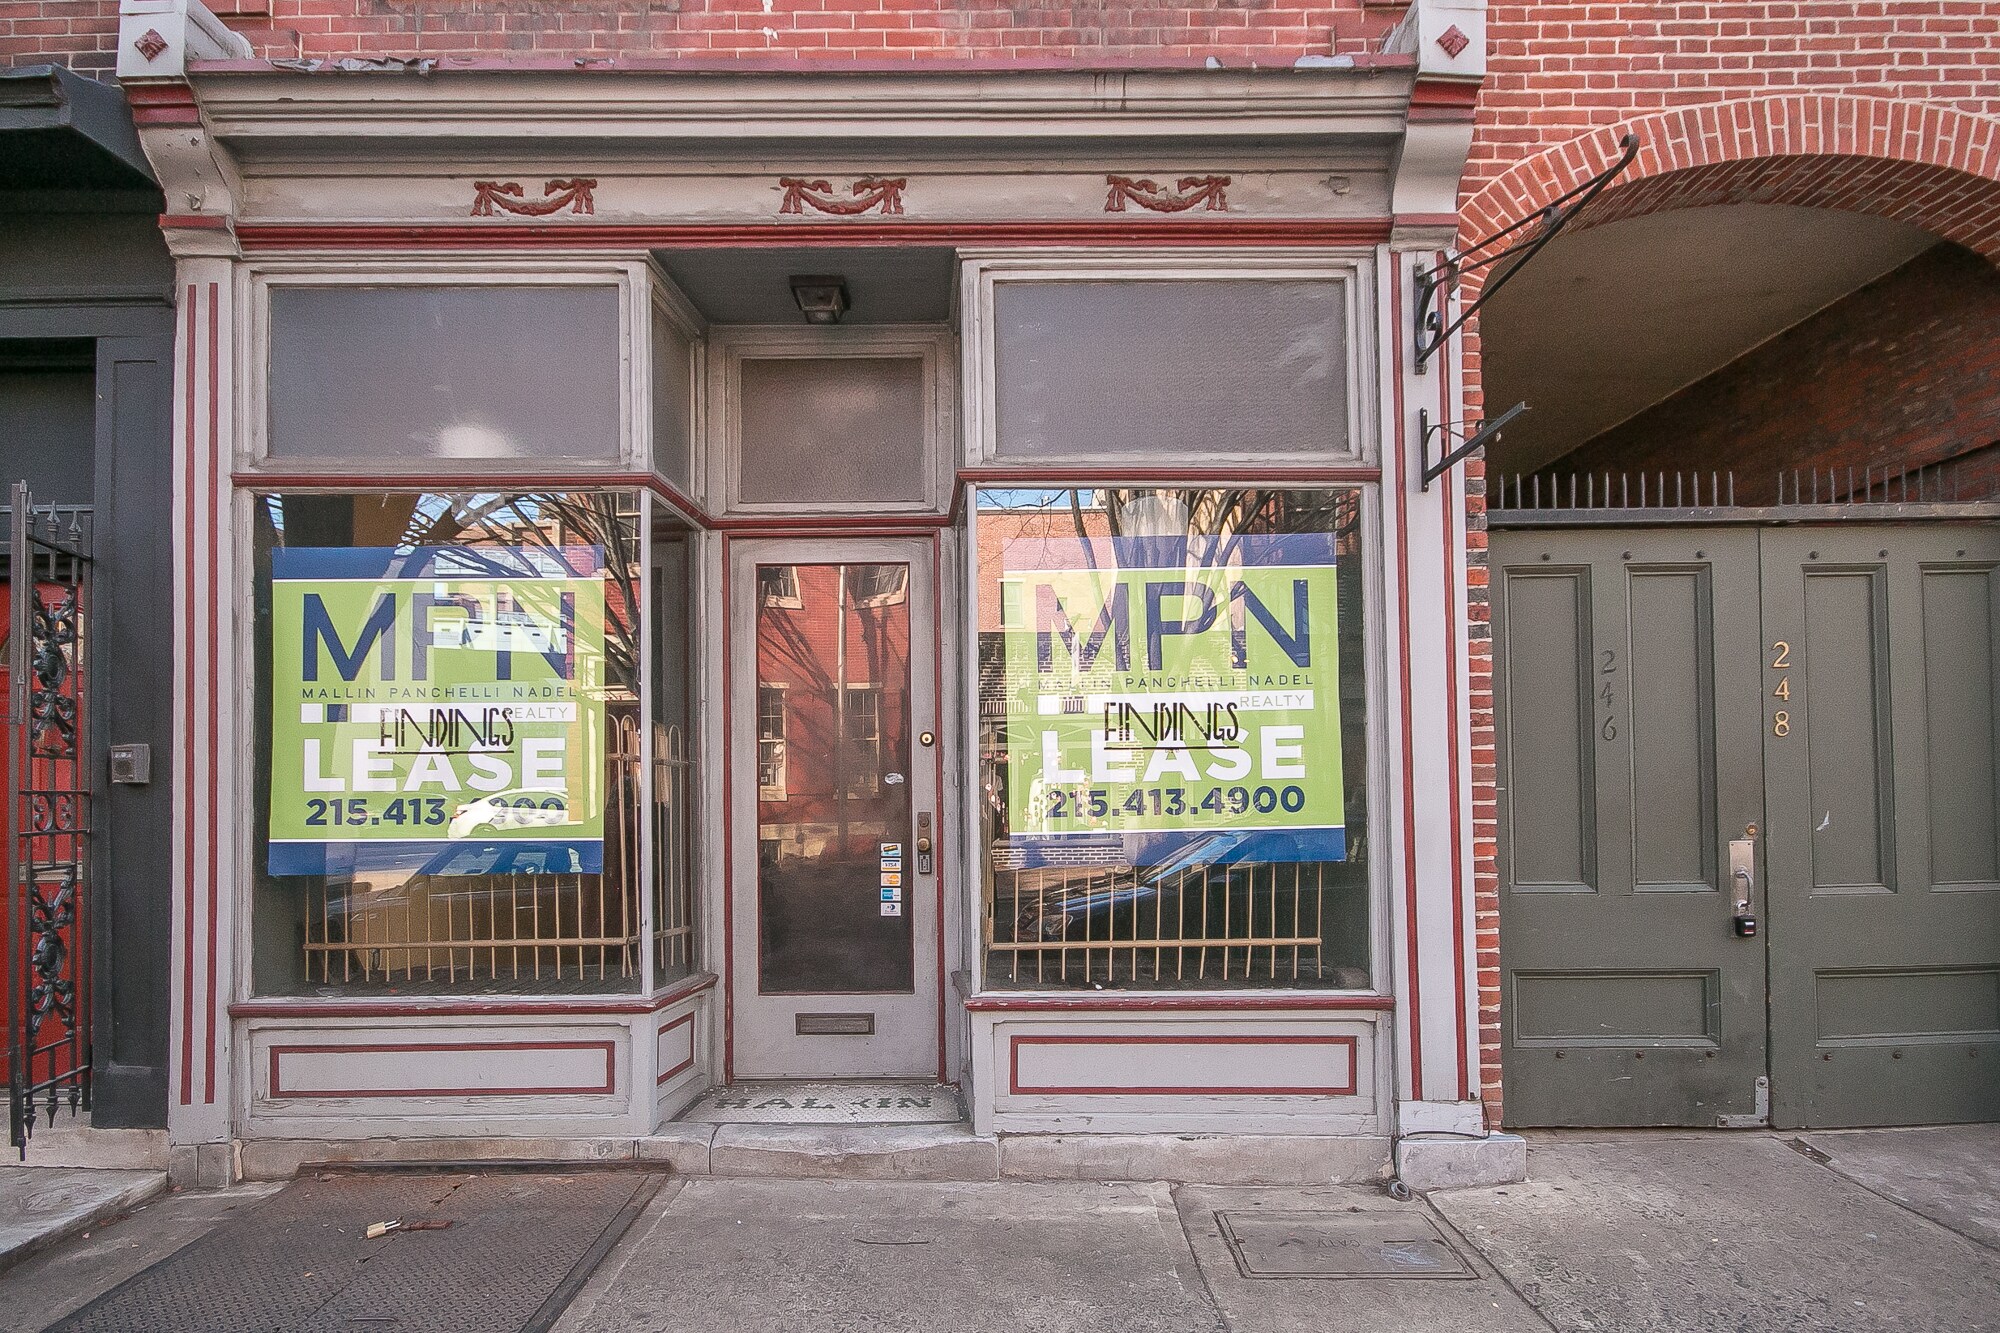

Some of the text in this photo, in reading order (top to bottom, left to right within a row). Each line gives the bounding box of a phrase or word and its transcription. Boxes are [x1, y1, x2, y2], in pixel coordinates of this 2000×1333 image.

[302, 592, 575, 681] MPN
[1035, 579, 1311, 673] MPN
[302, 685, 577, 699] MALLIN PANCHELLI NADEL
[1125, 675, 1235, 687] PANCHELLI
[1249, 674, 1314, 685] NADEL
[1239, 693, 1305, 707] REALTY
[1600, 650, 1617, 740] 246
[1772, 641, 1790, 736] 248
[379, 706, 514, 747] FINDINGS
[1103, 702, 1239, 741] FINDINGS
[303, 737, 567, 792] LEASE
[1041, 725, 1307, 784] LEASE
[1046, 785, 1306, 818] 215.413.4900
